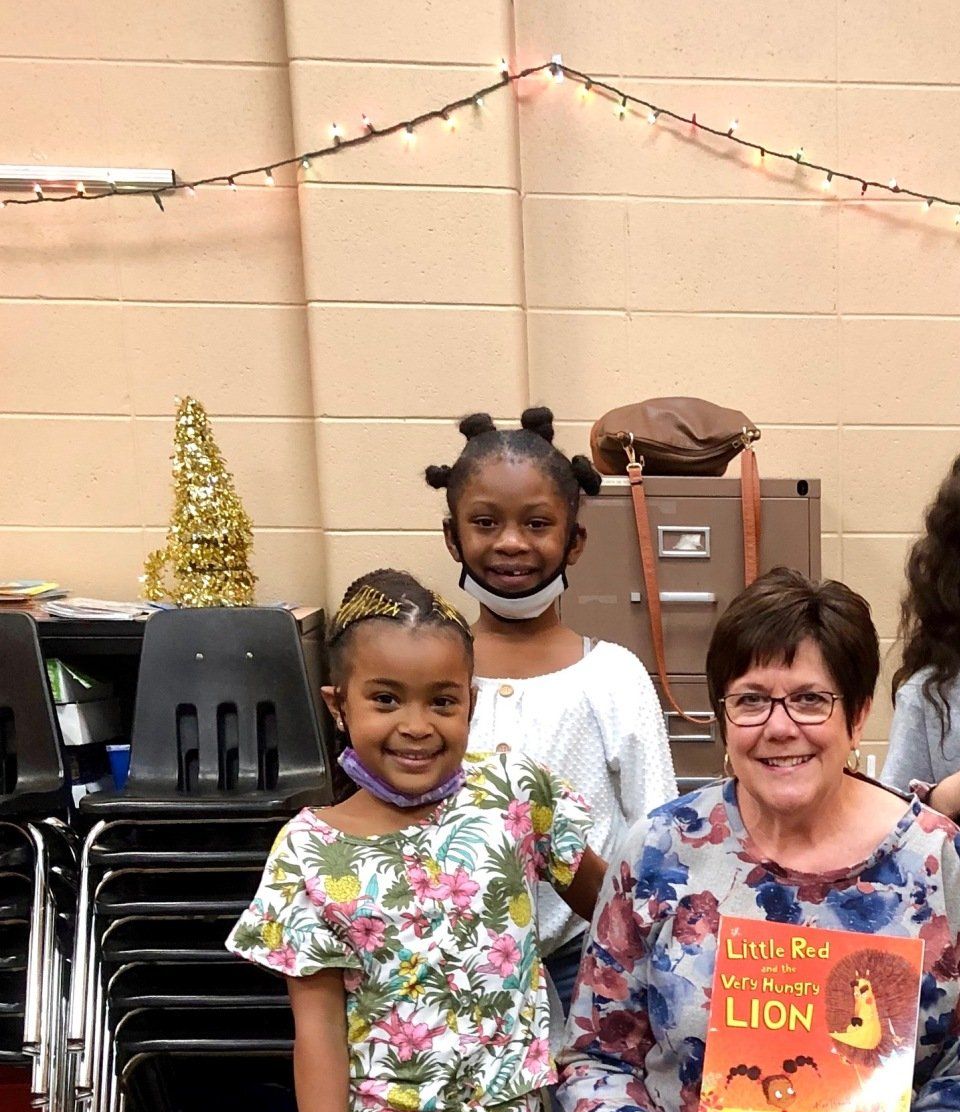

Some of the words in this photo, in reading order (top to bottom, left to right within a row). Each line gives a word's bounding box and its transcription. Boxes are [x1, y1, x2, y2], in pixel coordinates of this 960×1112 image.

[726, 938, 785, 960] Little
[791, 936, 830, 960] Red
[761, 964, 778, 974] and
[781, 963, 796, 973] the
[720, 973, 758, 991] Very
[762, 976, 820, 996] Hungry
[726, 995, 814, 1032] LION
